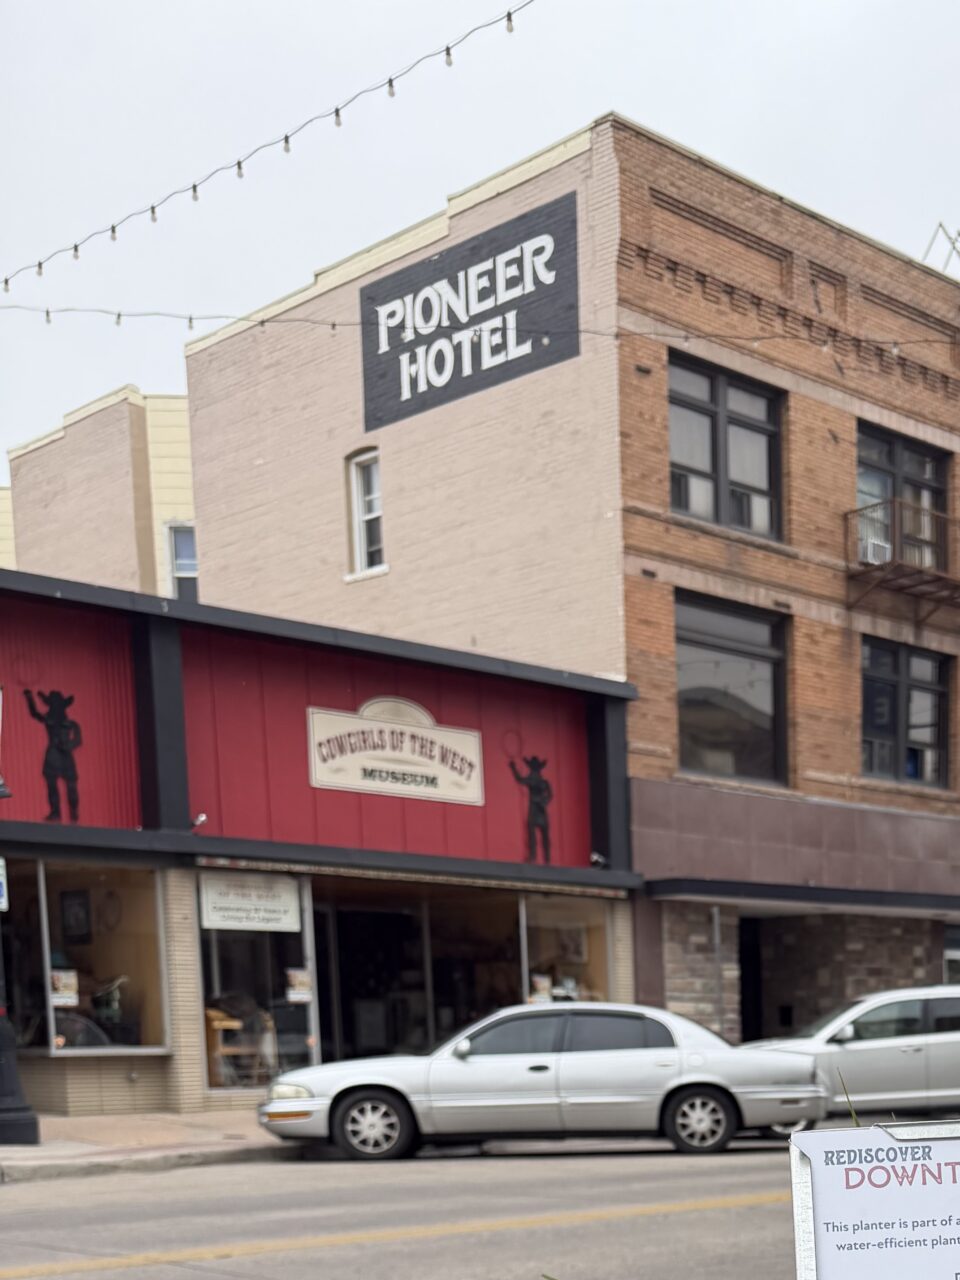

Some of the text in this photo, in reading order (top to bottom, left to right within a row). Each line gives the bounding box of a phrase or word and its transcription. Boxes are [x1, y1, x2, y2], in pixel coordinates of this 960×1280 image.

[375, 234, 556, 354] PIONEER
[399, 309, 532, 401] HOTEL
[317, 729, 475, 781] COWGIRLS OF THE WEST
[360, 766, 439, 789] MUSEUM
[823, 1145, 932, 1166] REDISCOVER
[823, 1221, 849, 1233] This
[852, 1219, 896, 1234] planter
[899, 1218, 908, 1229] is
[911, 1217, 937, 1232] part
[940, 1215, 953, 1226] of
[836, 1236, 928, 1251] water-efficient
